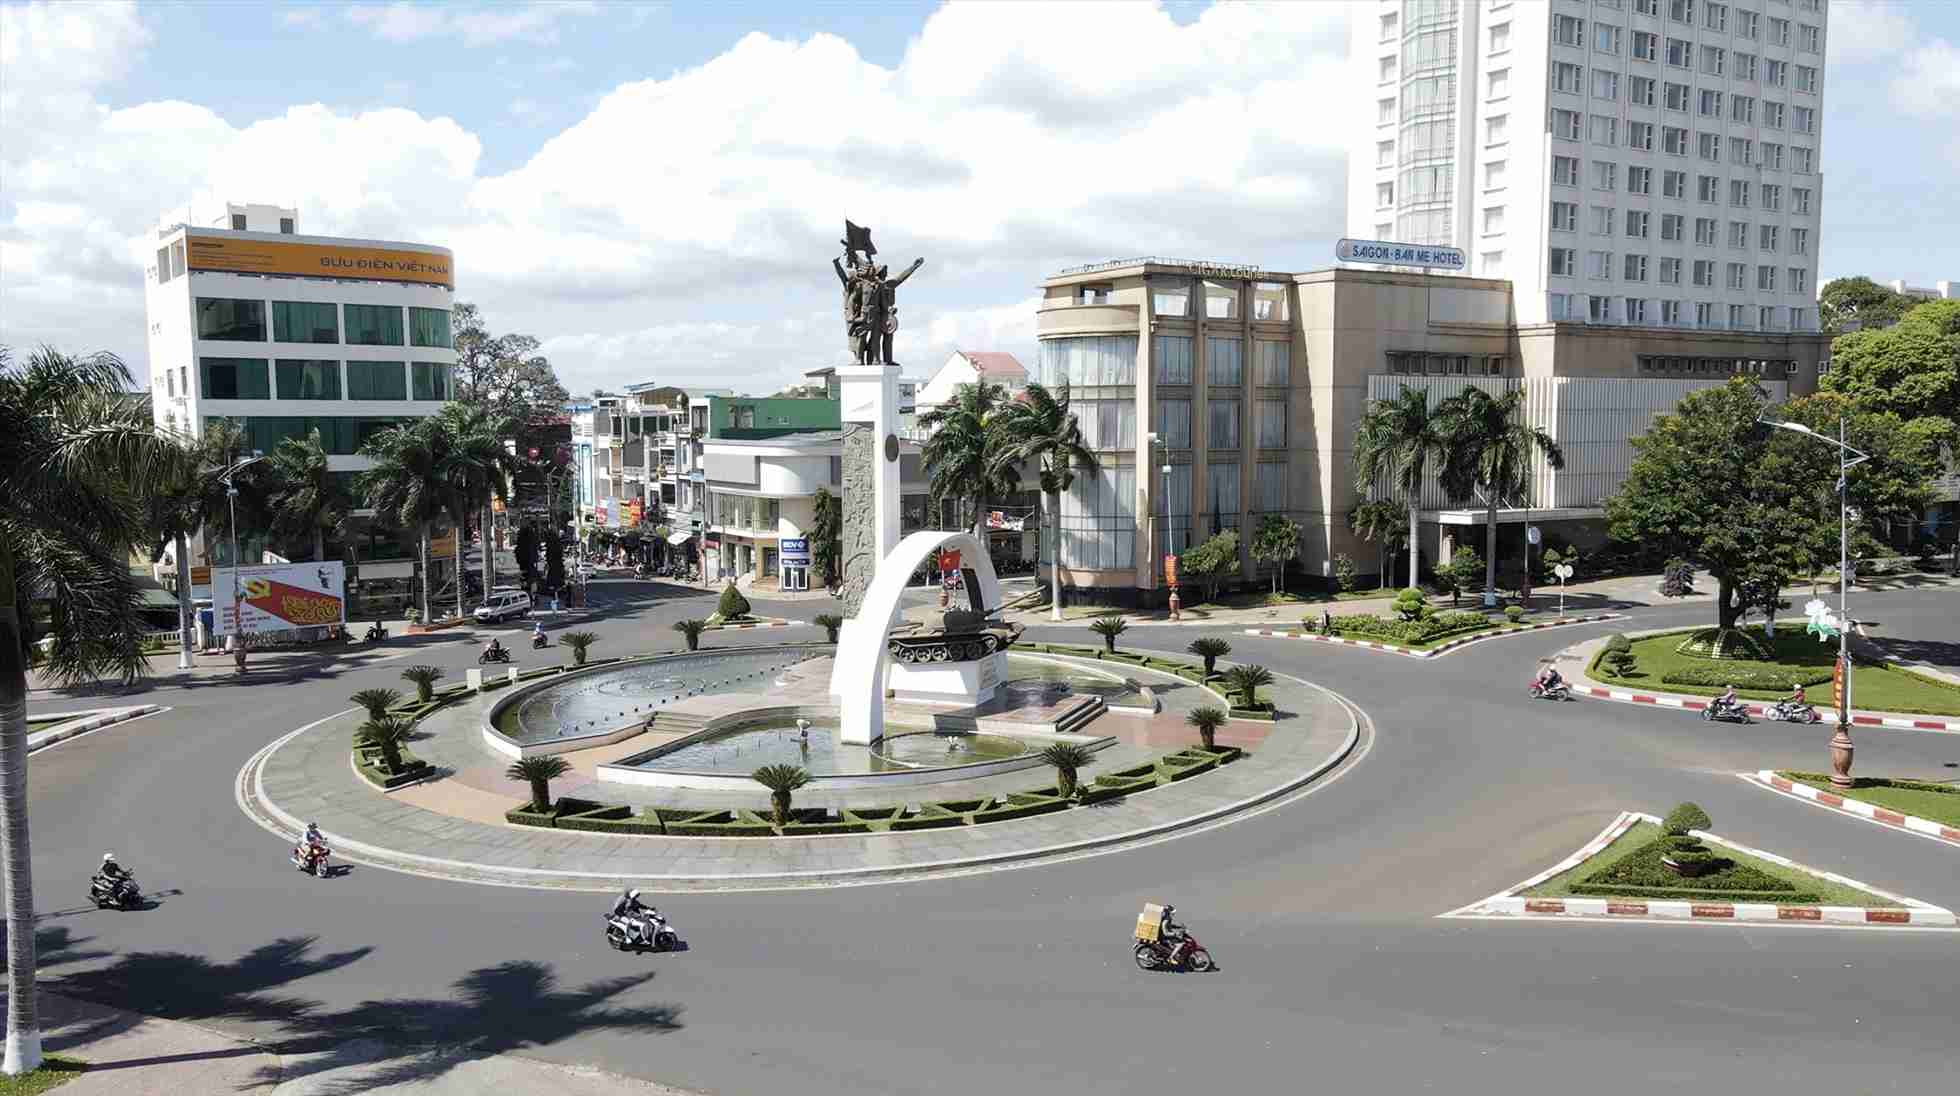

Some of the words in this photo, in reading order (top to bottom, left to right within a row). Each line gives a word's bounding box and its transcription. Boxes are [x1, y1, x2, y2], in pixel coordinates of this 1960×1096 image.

[1352, 245, 1389, 259] SAIGON
[1395, 248, 1415, 261] BAN
[1433, 250, 1463, 265] HOTEL
